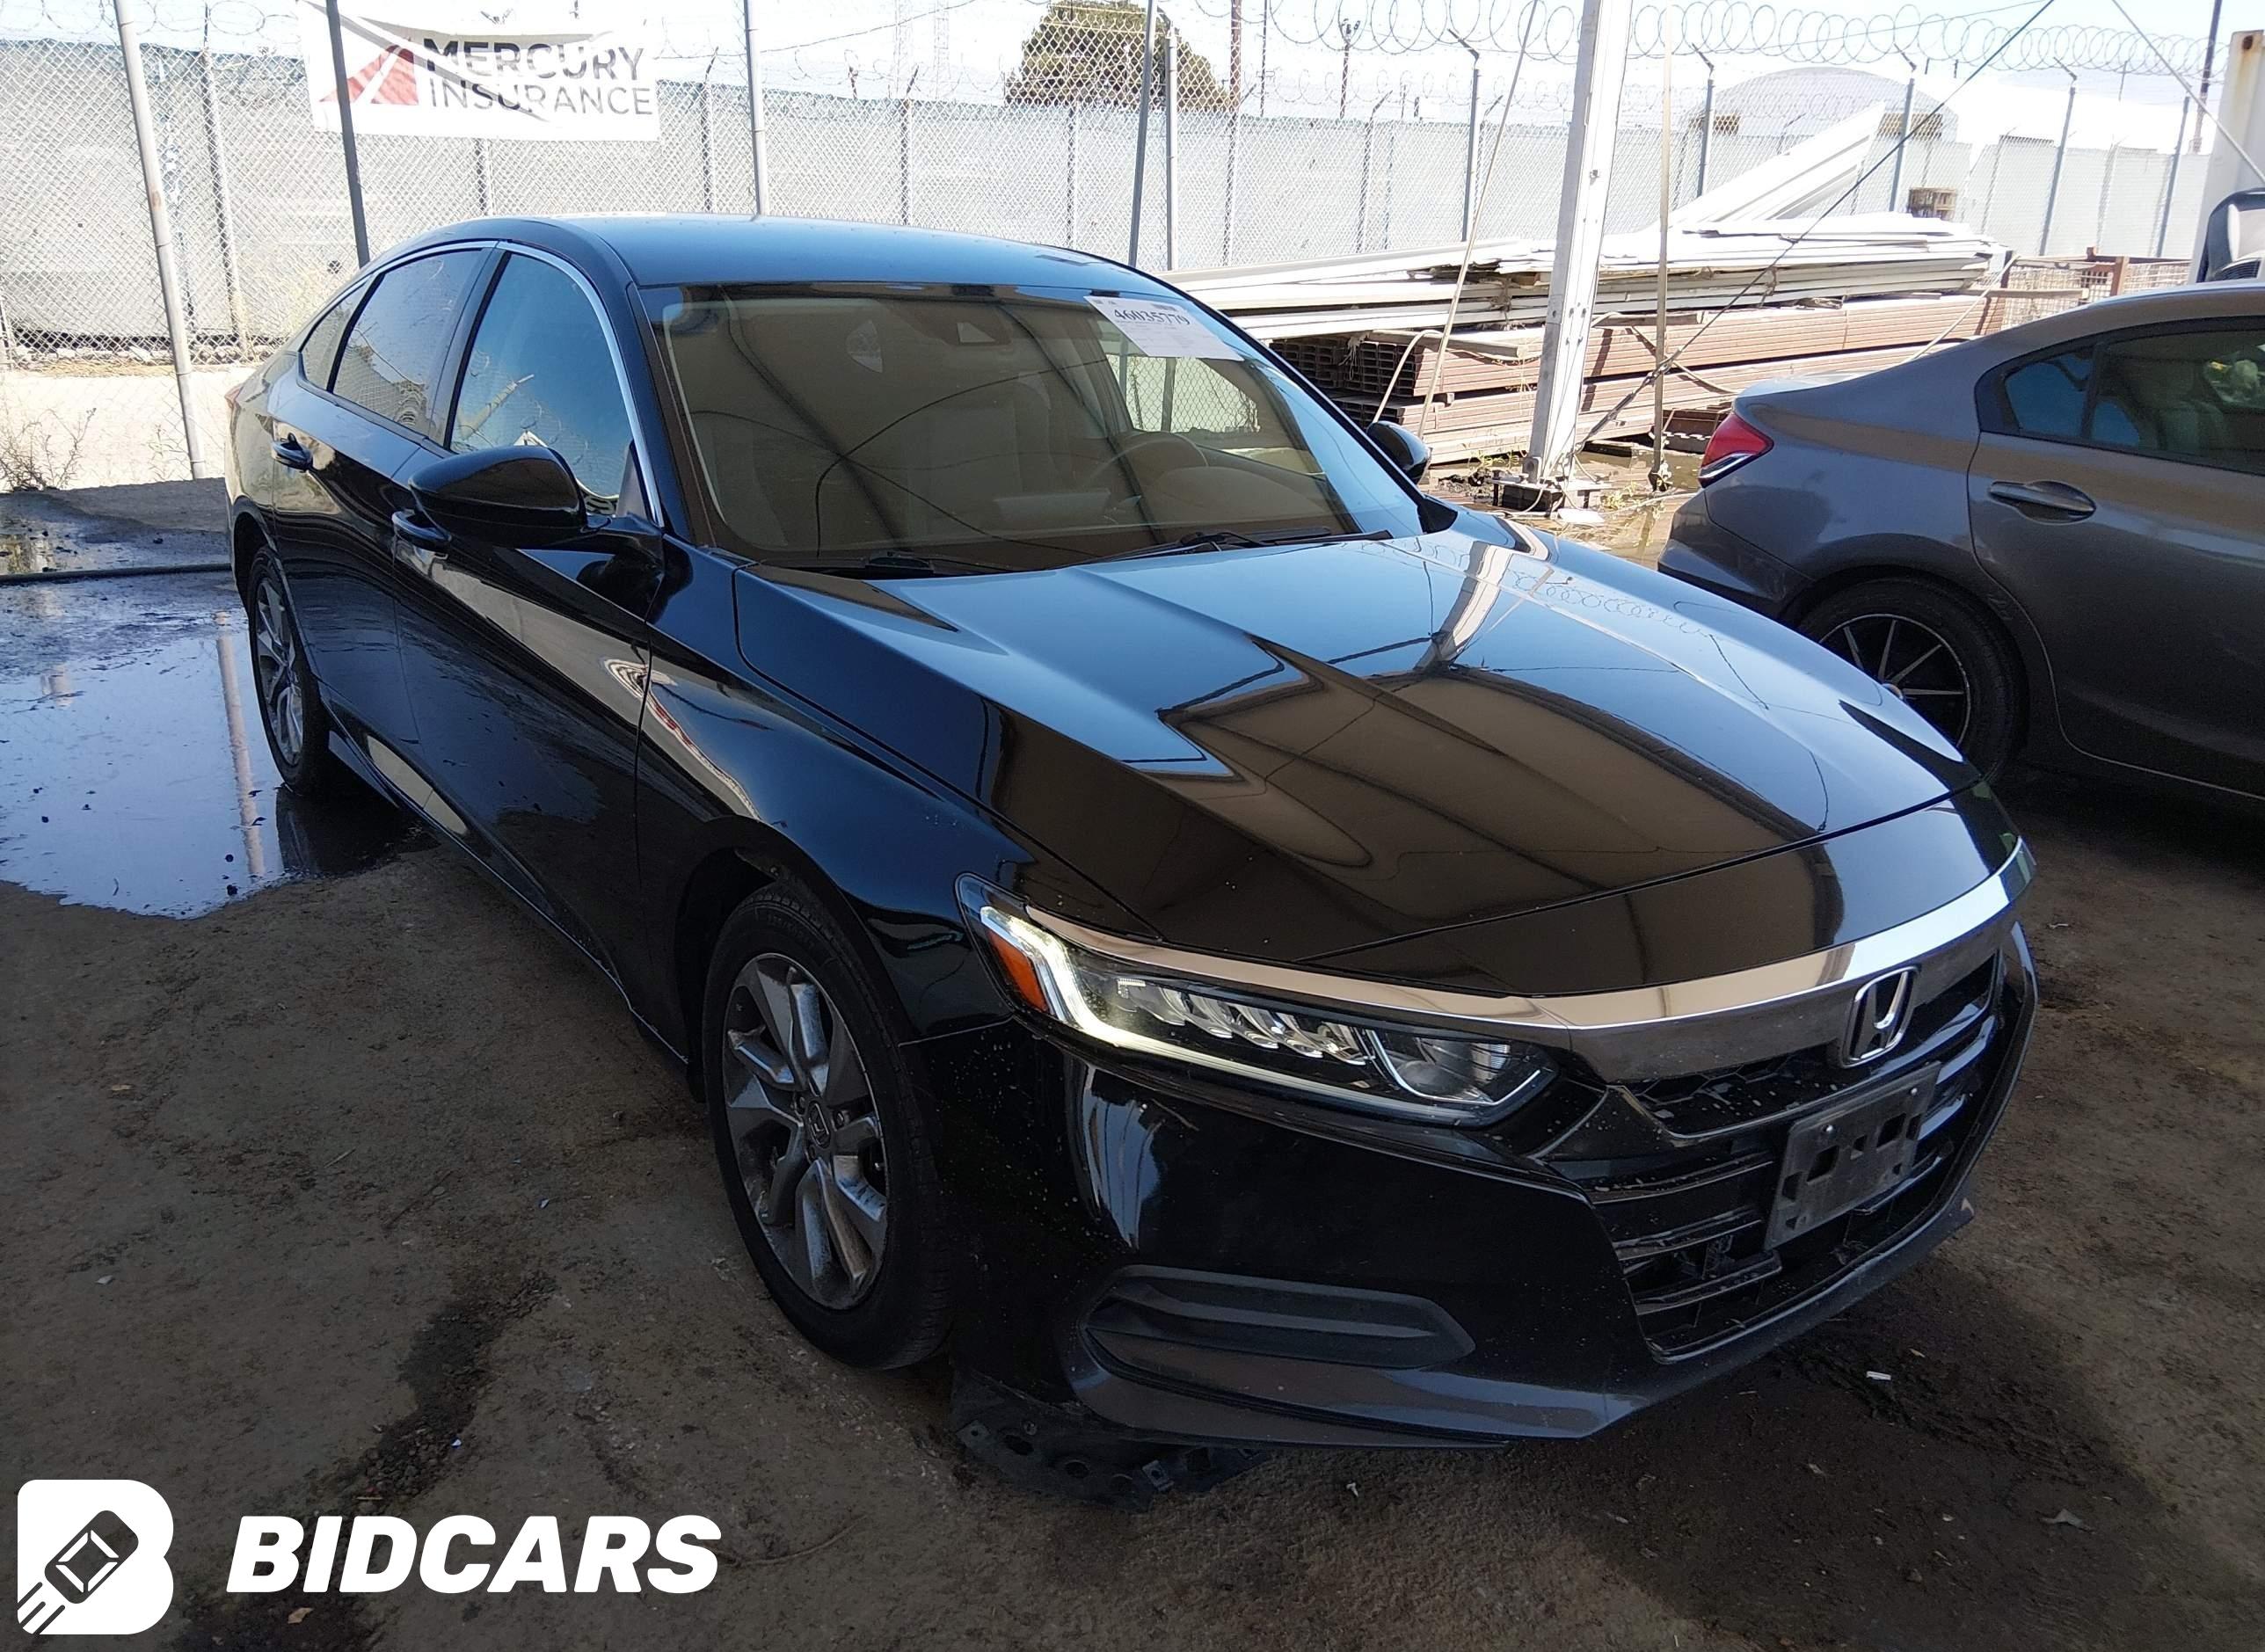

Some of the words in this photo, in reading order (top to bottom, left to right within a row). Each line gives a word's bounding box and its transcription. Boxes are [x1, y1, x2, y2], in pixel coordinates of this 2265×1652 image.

[424, 38, 644, 81] MERCURY
[428, 78, 653, 115] INSURANCE
[1114, 309, 1190, 325] 46035779
